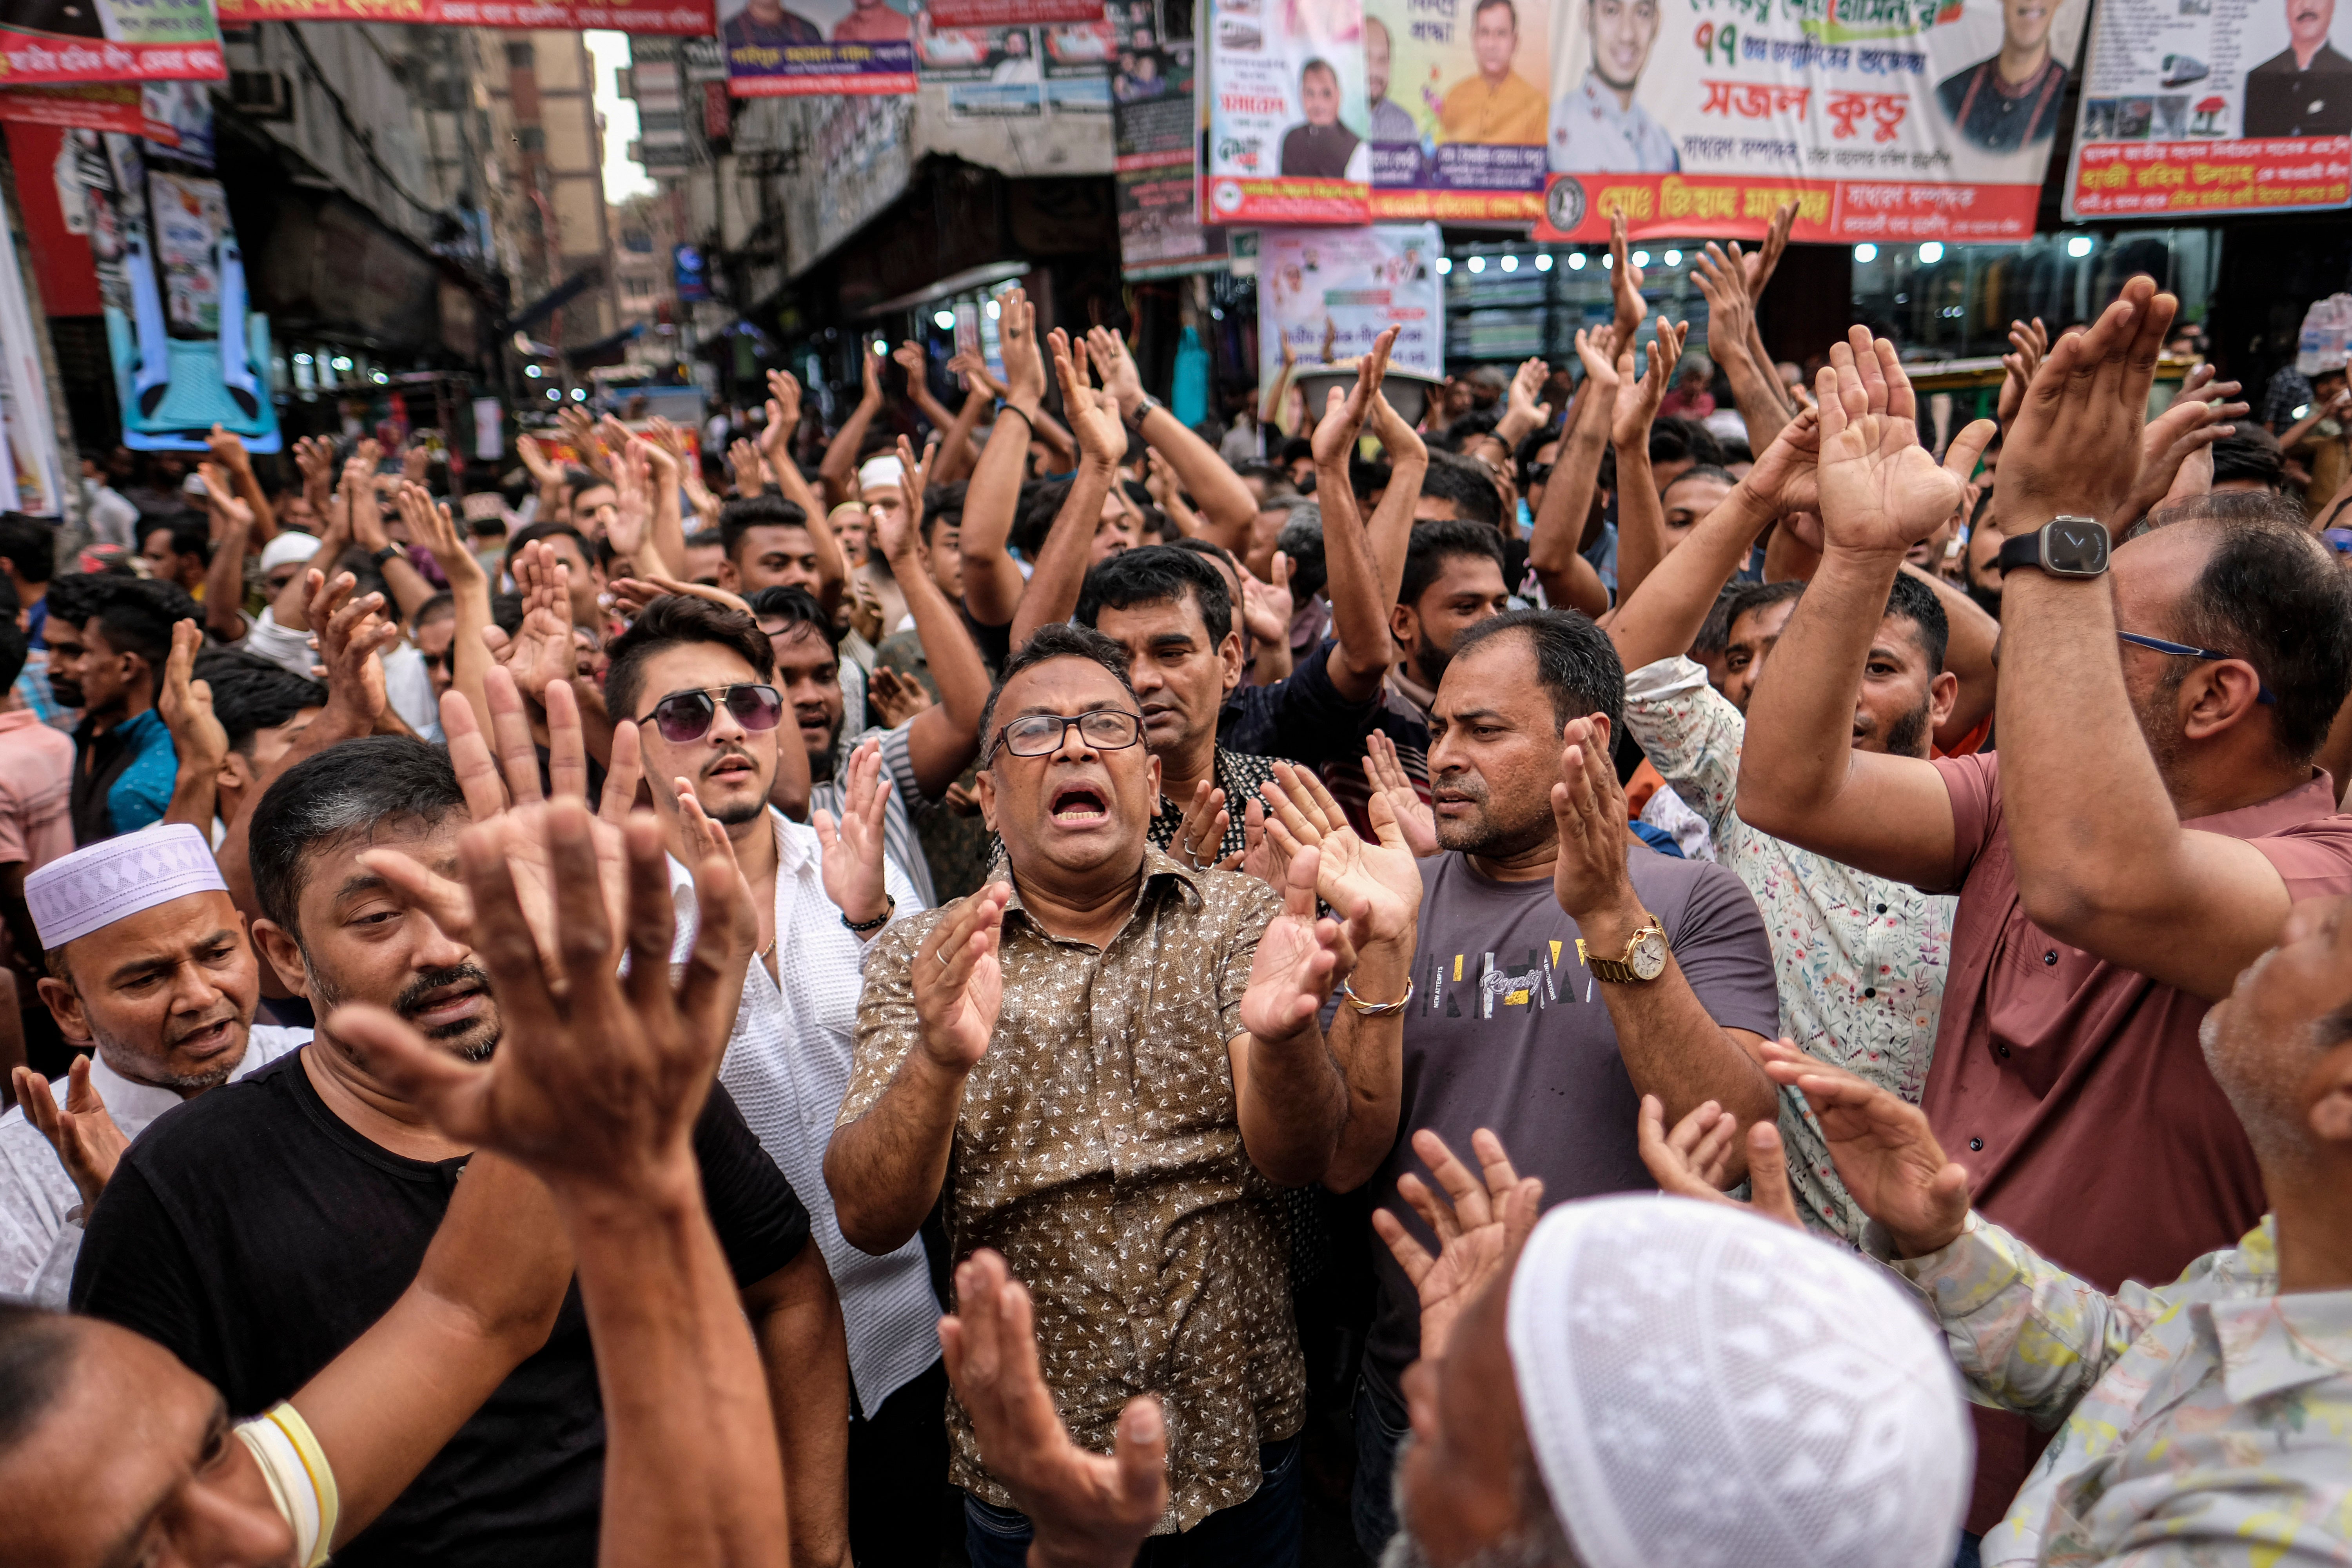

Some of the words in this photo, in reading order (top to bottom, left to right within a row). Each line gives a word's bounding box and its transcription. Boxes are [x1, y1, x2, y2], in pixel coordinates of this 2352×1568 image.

[1695, 19, 1737, 66] ৭৭
[1701, 80, 1811, 121] সজল
[1827, 89, 1909, 143] কুন্ডু
[1847, 186, 1905, 209] সাধারণ
[1909, 186, 1976, 211] সম্পাদক
[1435, 966, 1444, 995] ATTEMPTS
